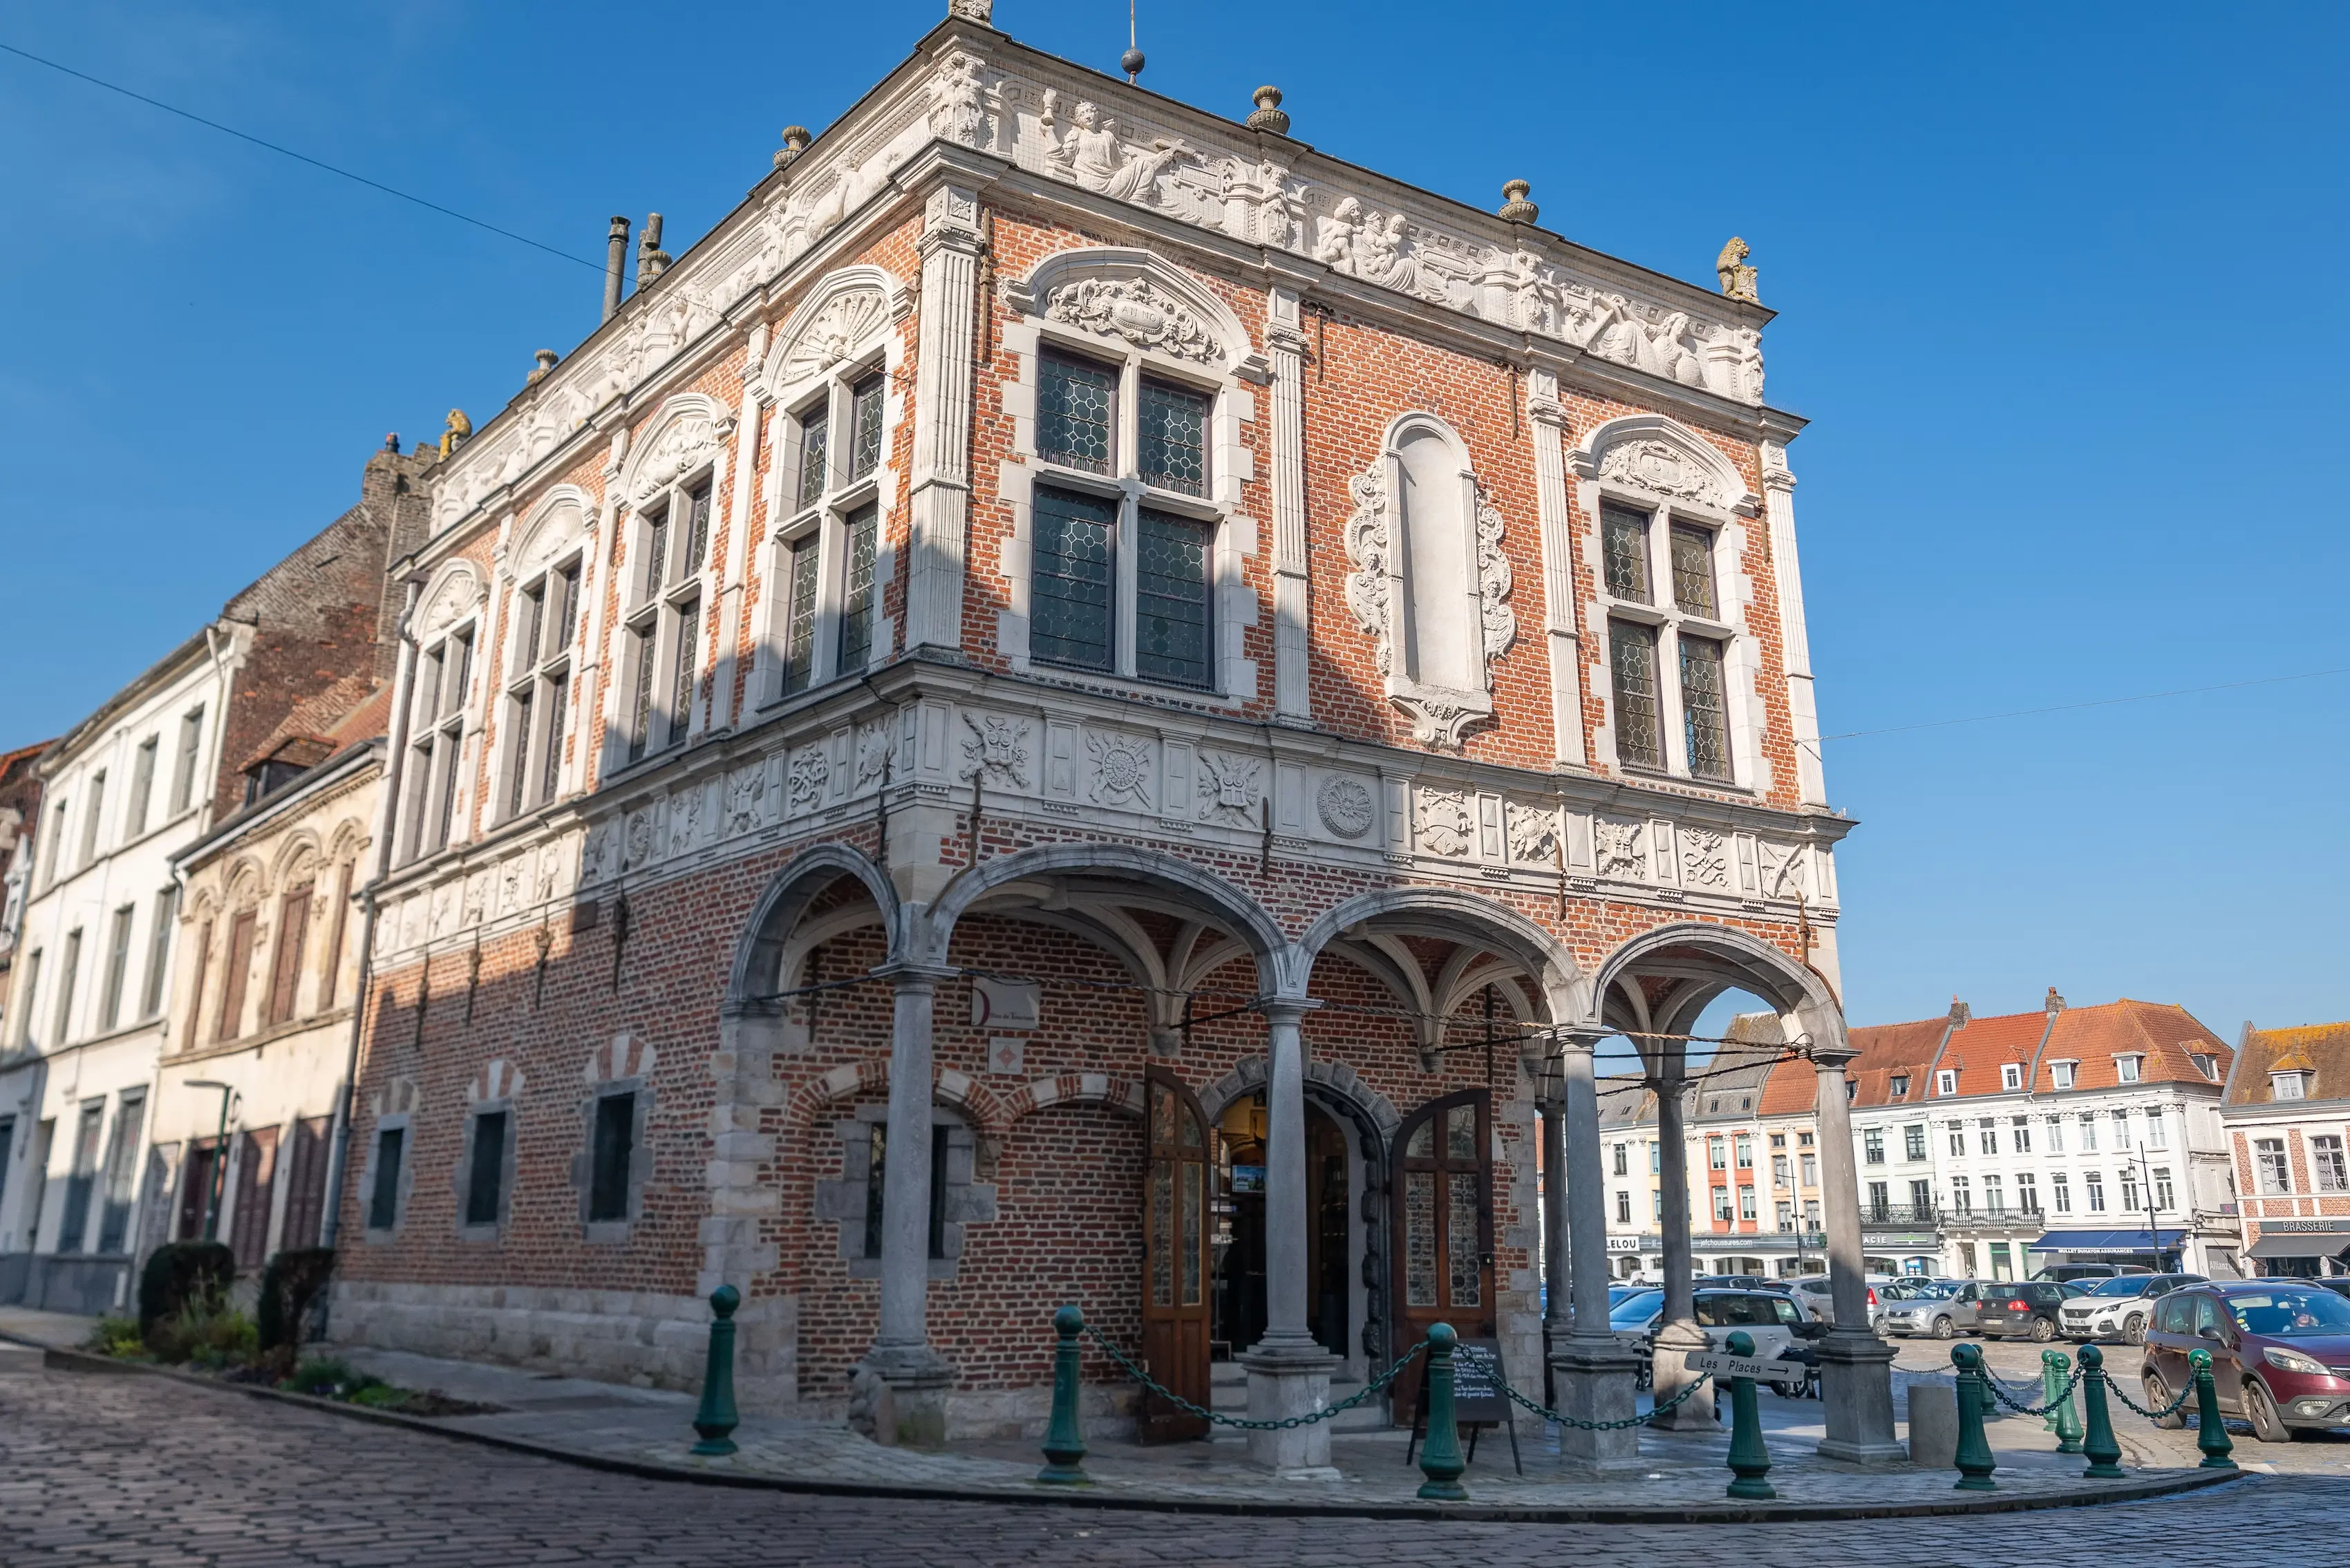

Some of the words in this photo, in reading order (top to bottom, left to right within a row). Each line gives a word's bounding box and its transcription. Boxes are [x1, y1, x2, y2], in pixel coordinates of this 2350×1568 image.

[2283, 1220, 2334, 1231] BRASSERIE
[1700, 1238, 1754, 1247] jefchaussures.com
[2210, 1260, 2229, 1270] Allianz
[1700, 1357, 1718, 1369] Les
[1728, 1360, 1762, 1374] Places
